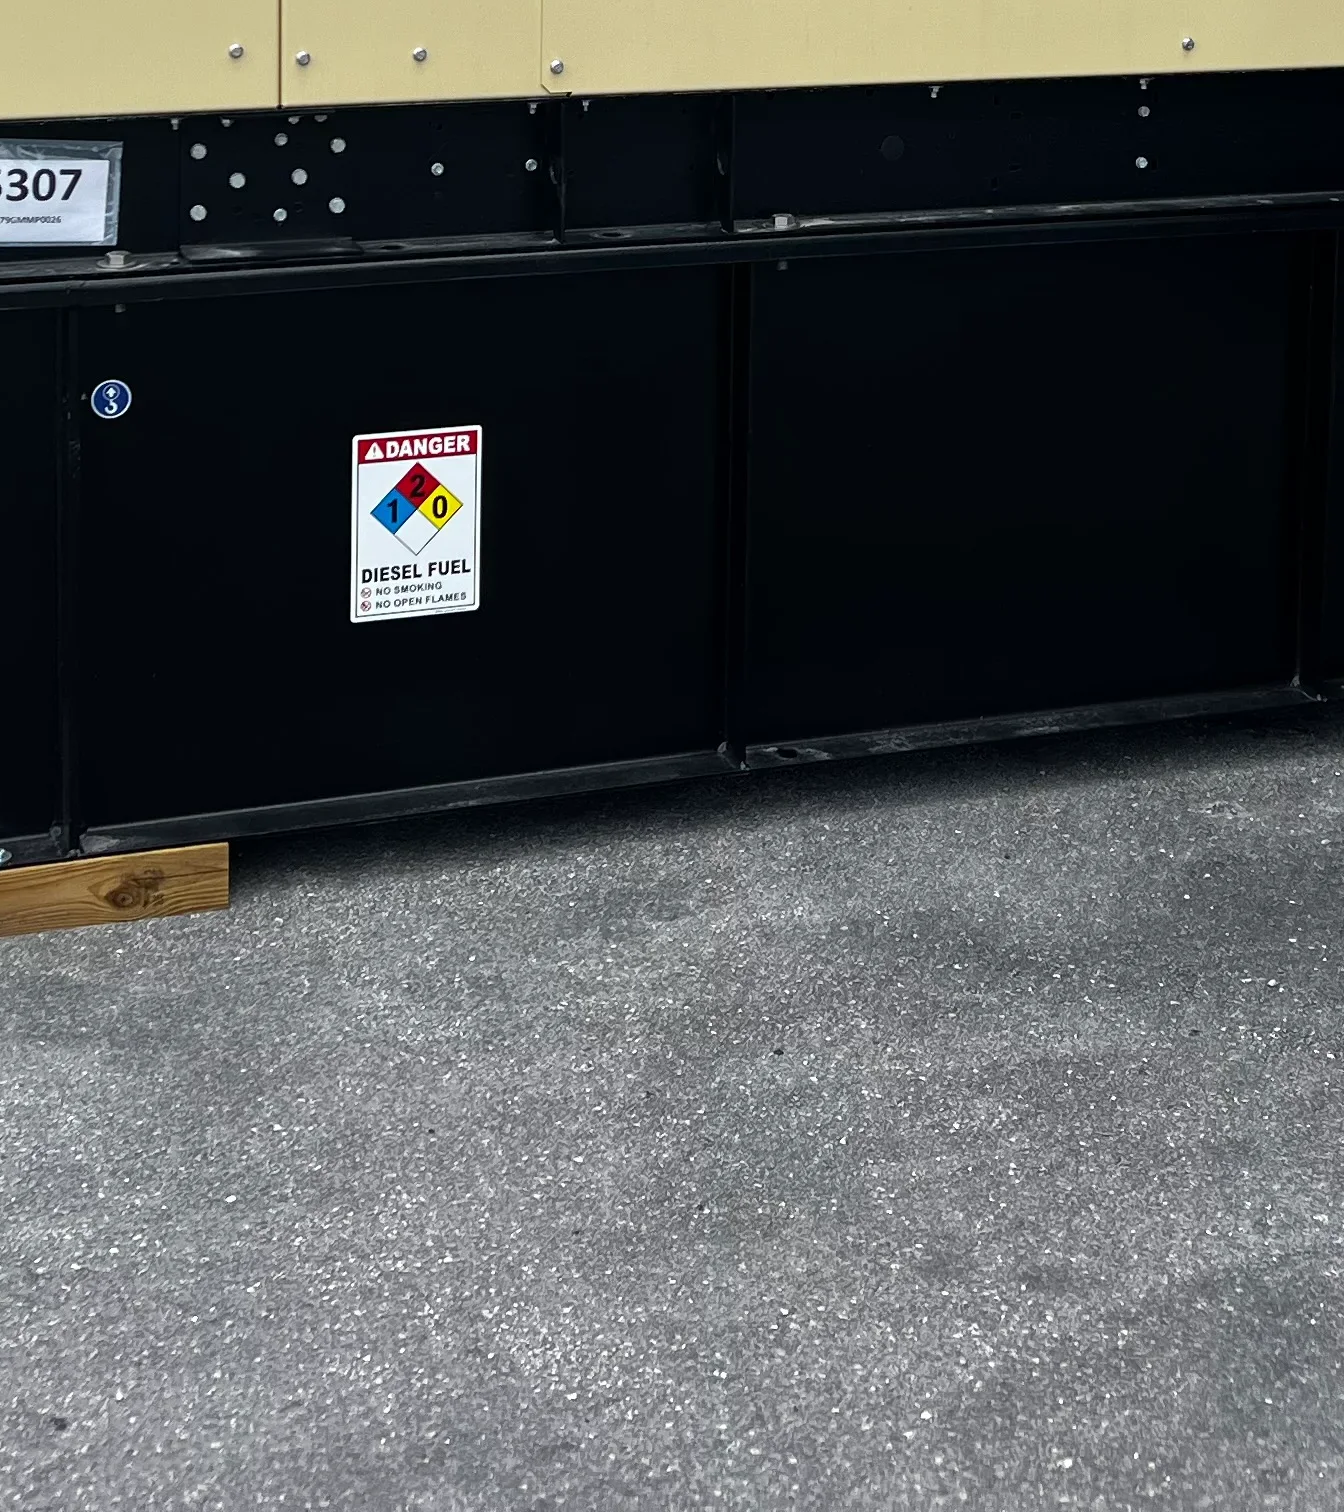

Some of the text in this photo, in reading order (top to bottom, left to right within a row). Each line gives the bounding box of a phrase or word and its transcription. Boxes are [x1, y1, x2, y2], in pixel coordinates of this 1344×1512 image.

[385, 434, 471, 459] DANGER
[410, 474, 426, 498] 2
[386, 495, 448, 523] 1 0
[361, 558, 471, 584] DIESEL FUEL
[376, 581, 443, 596] NO SMOKING
[376, 591, 467, 609] NO OPEN FLAMES
